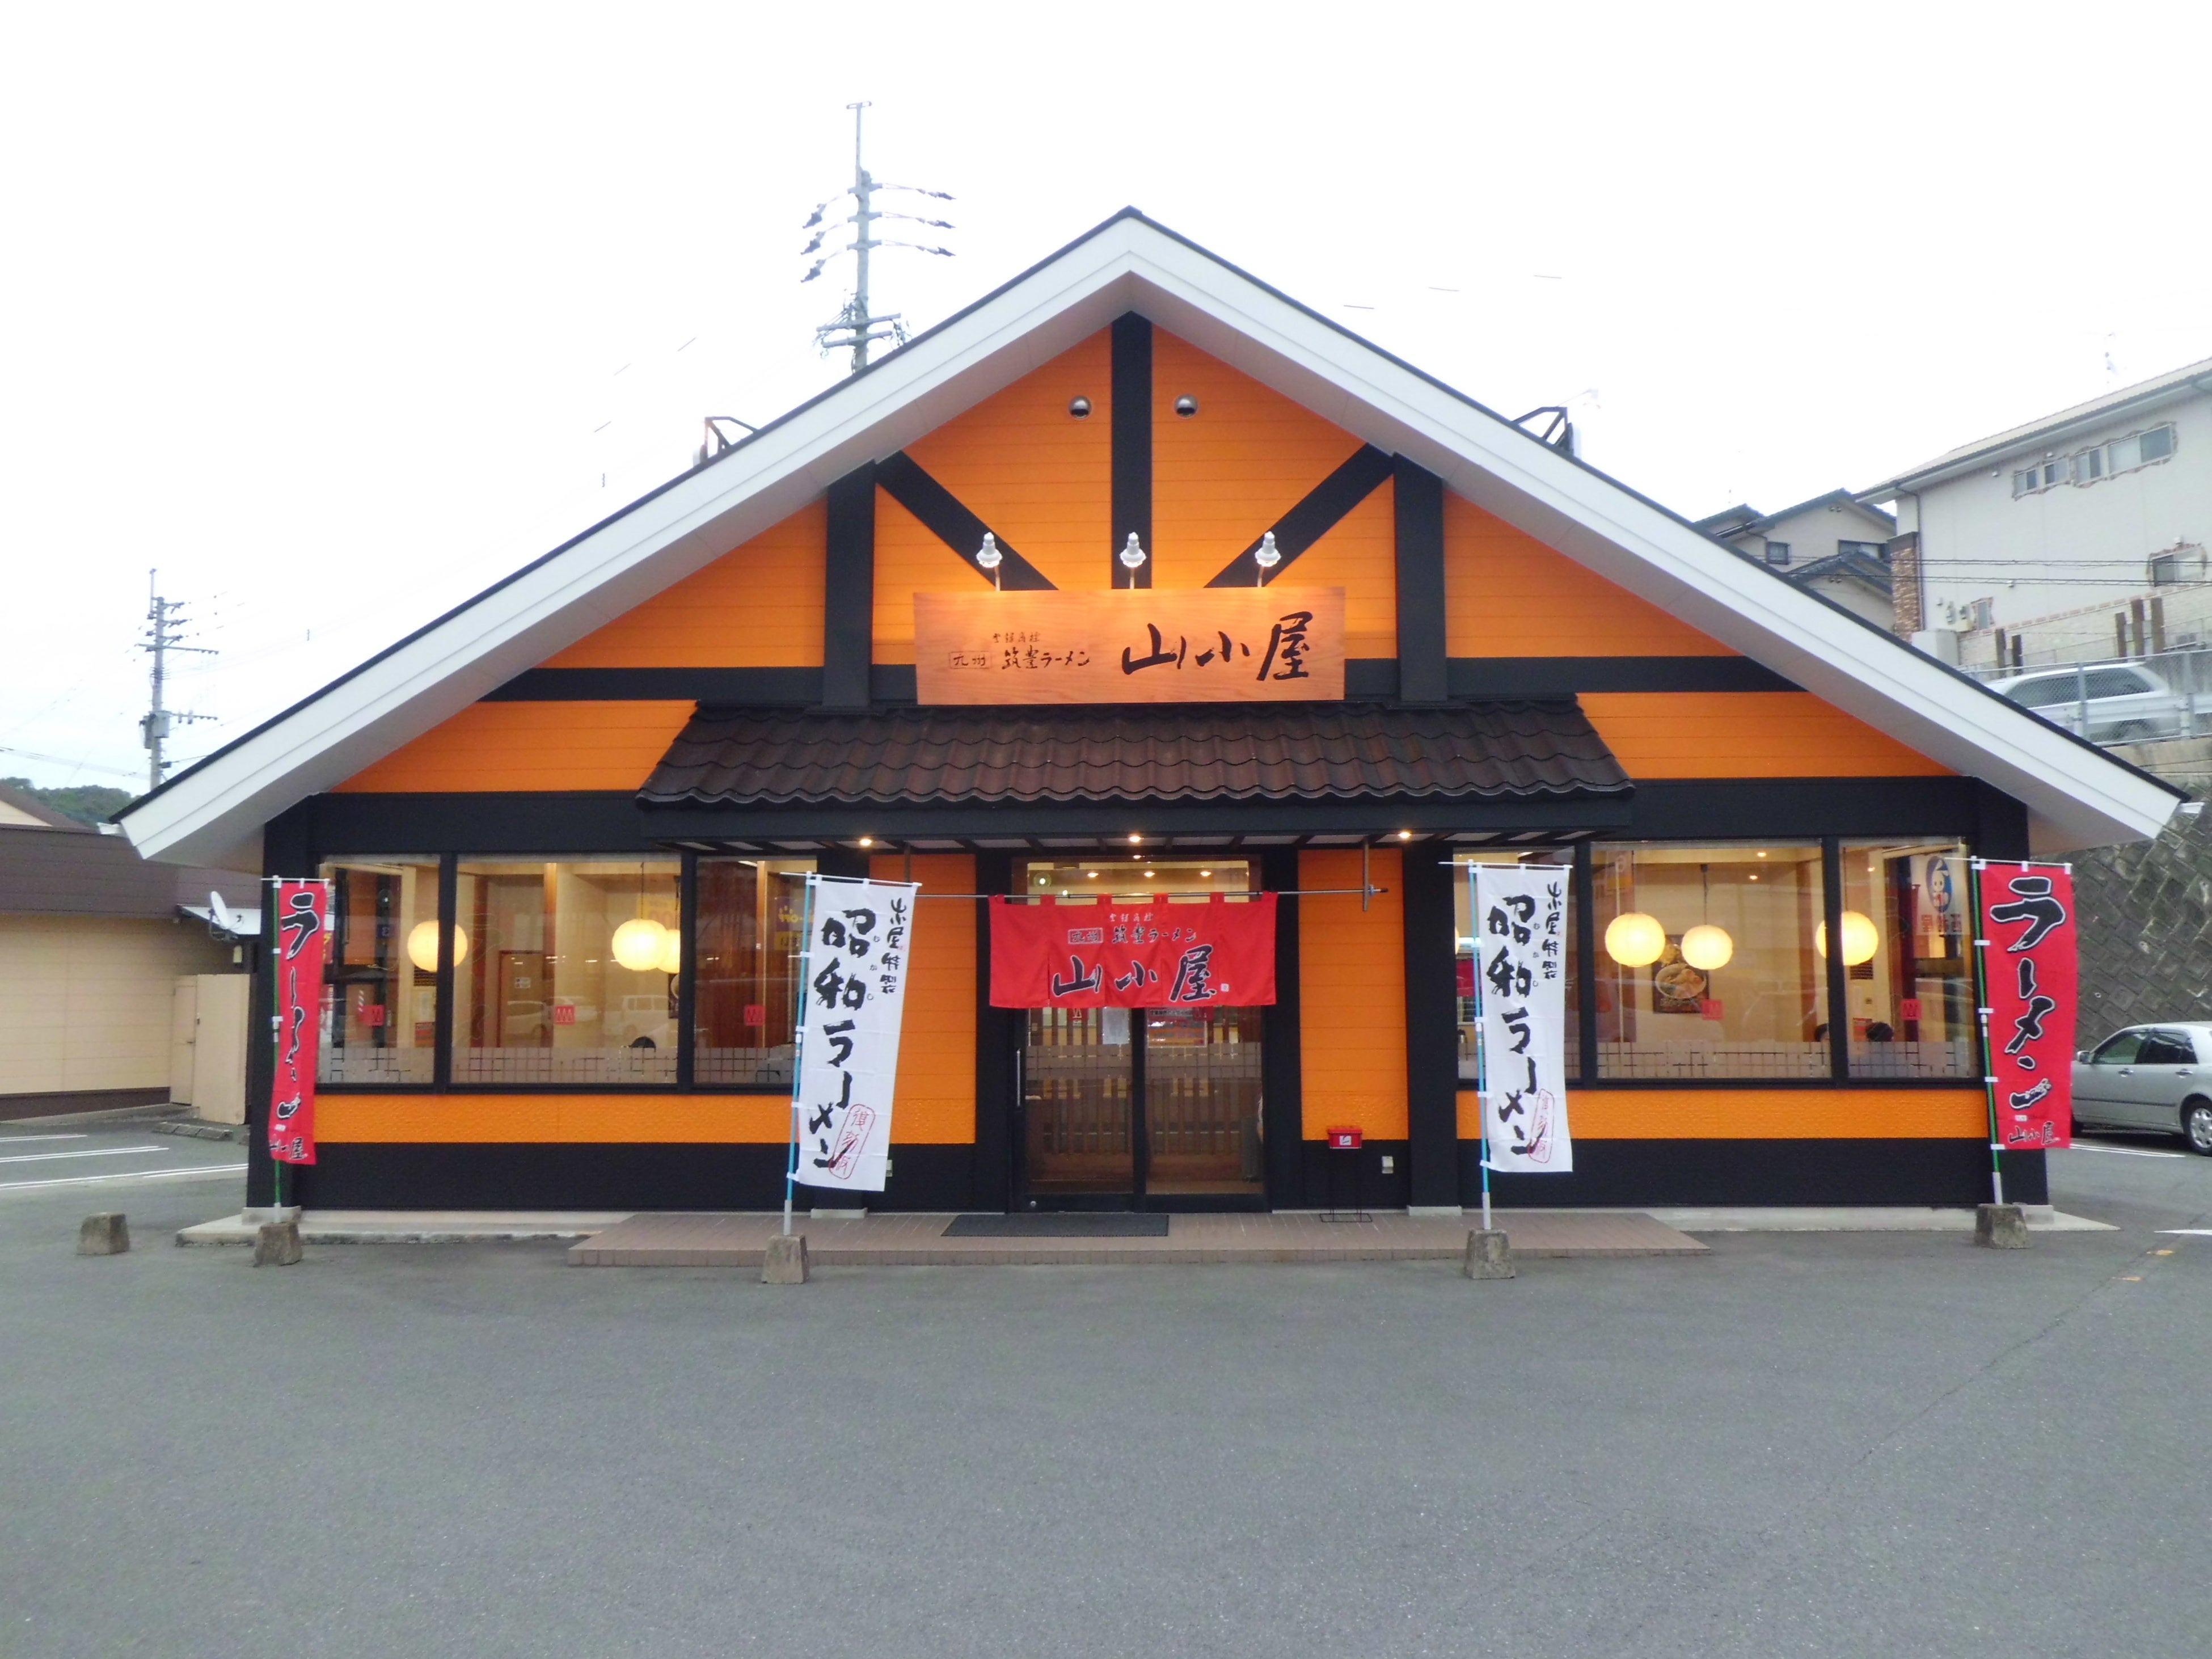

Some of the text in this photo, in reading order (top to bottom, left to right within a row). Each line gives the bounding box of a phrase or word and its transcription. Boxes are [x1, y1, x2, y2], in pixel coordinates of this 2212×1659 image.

[1121, 611, 1314, 682] 山小屋
[809, 907, 876, 1168] 昭和ラーメン
[1052, 944, 1217, 1002] 山小屋
[1486, 893, 1546, 1155] 昭和ラーメン
[1989, 875, 2066, 1110] ラーメン
[2008, 1120, 2062, 1146] 山小屋
